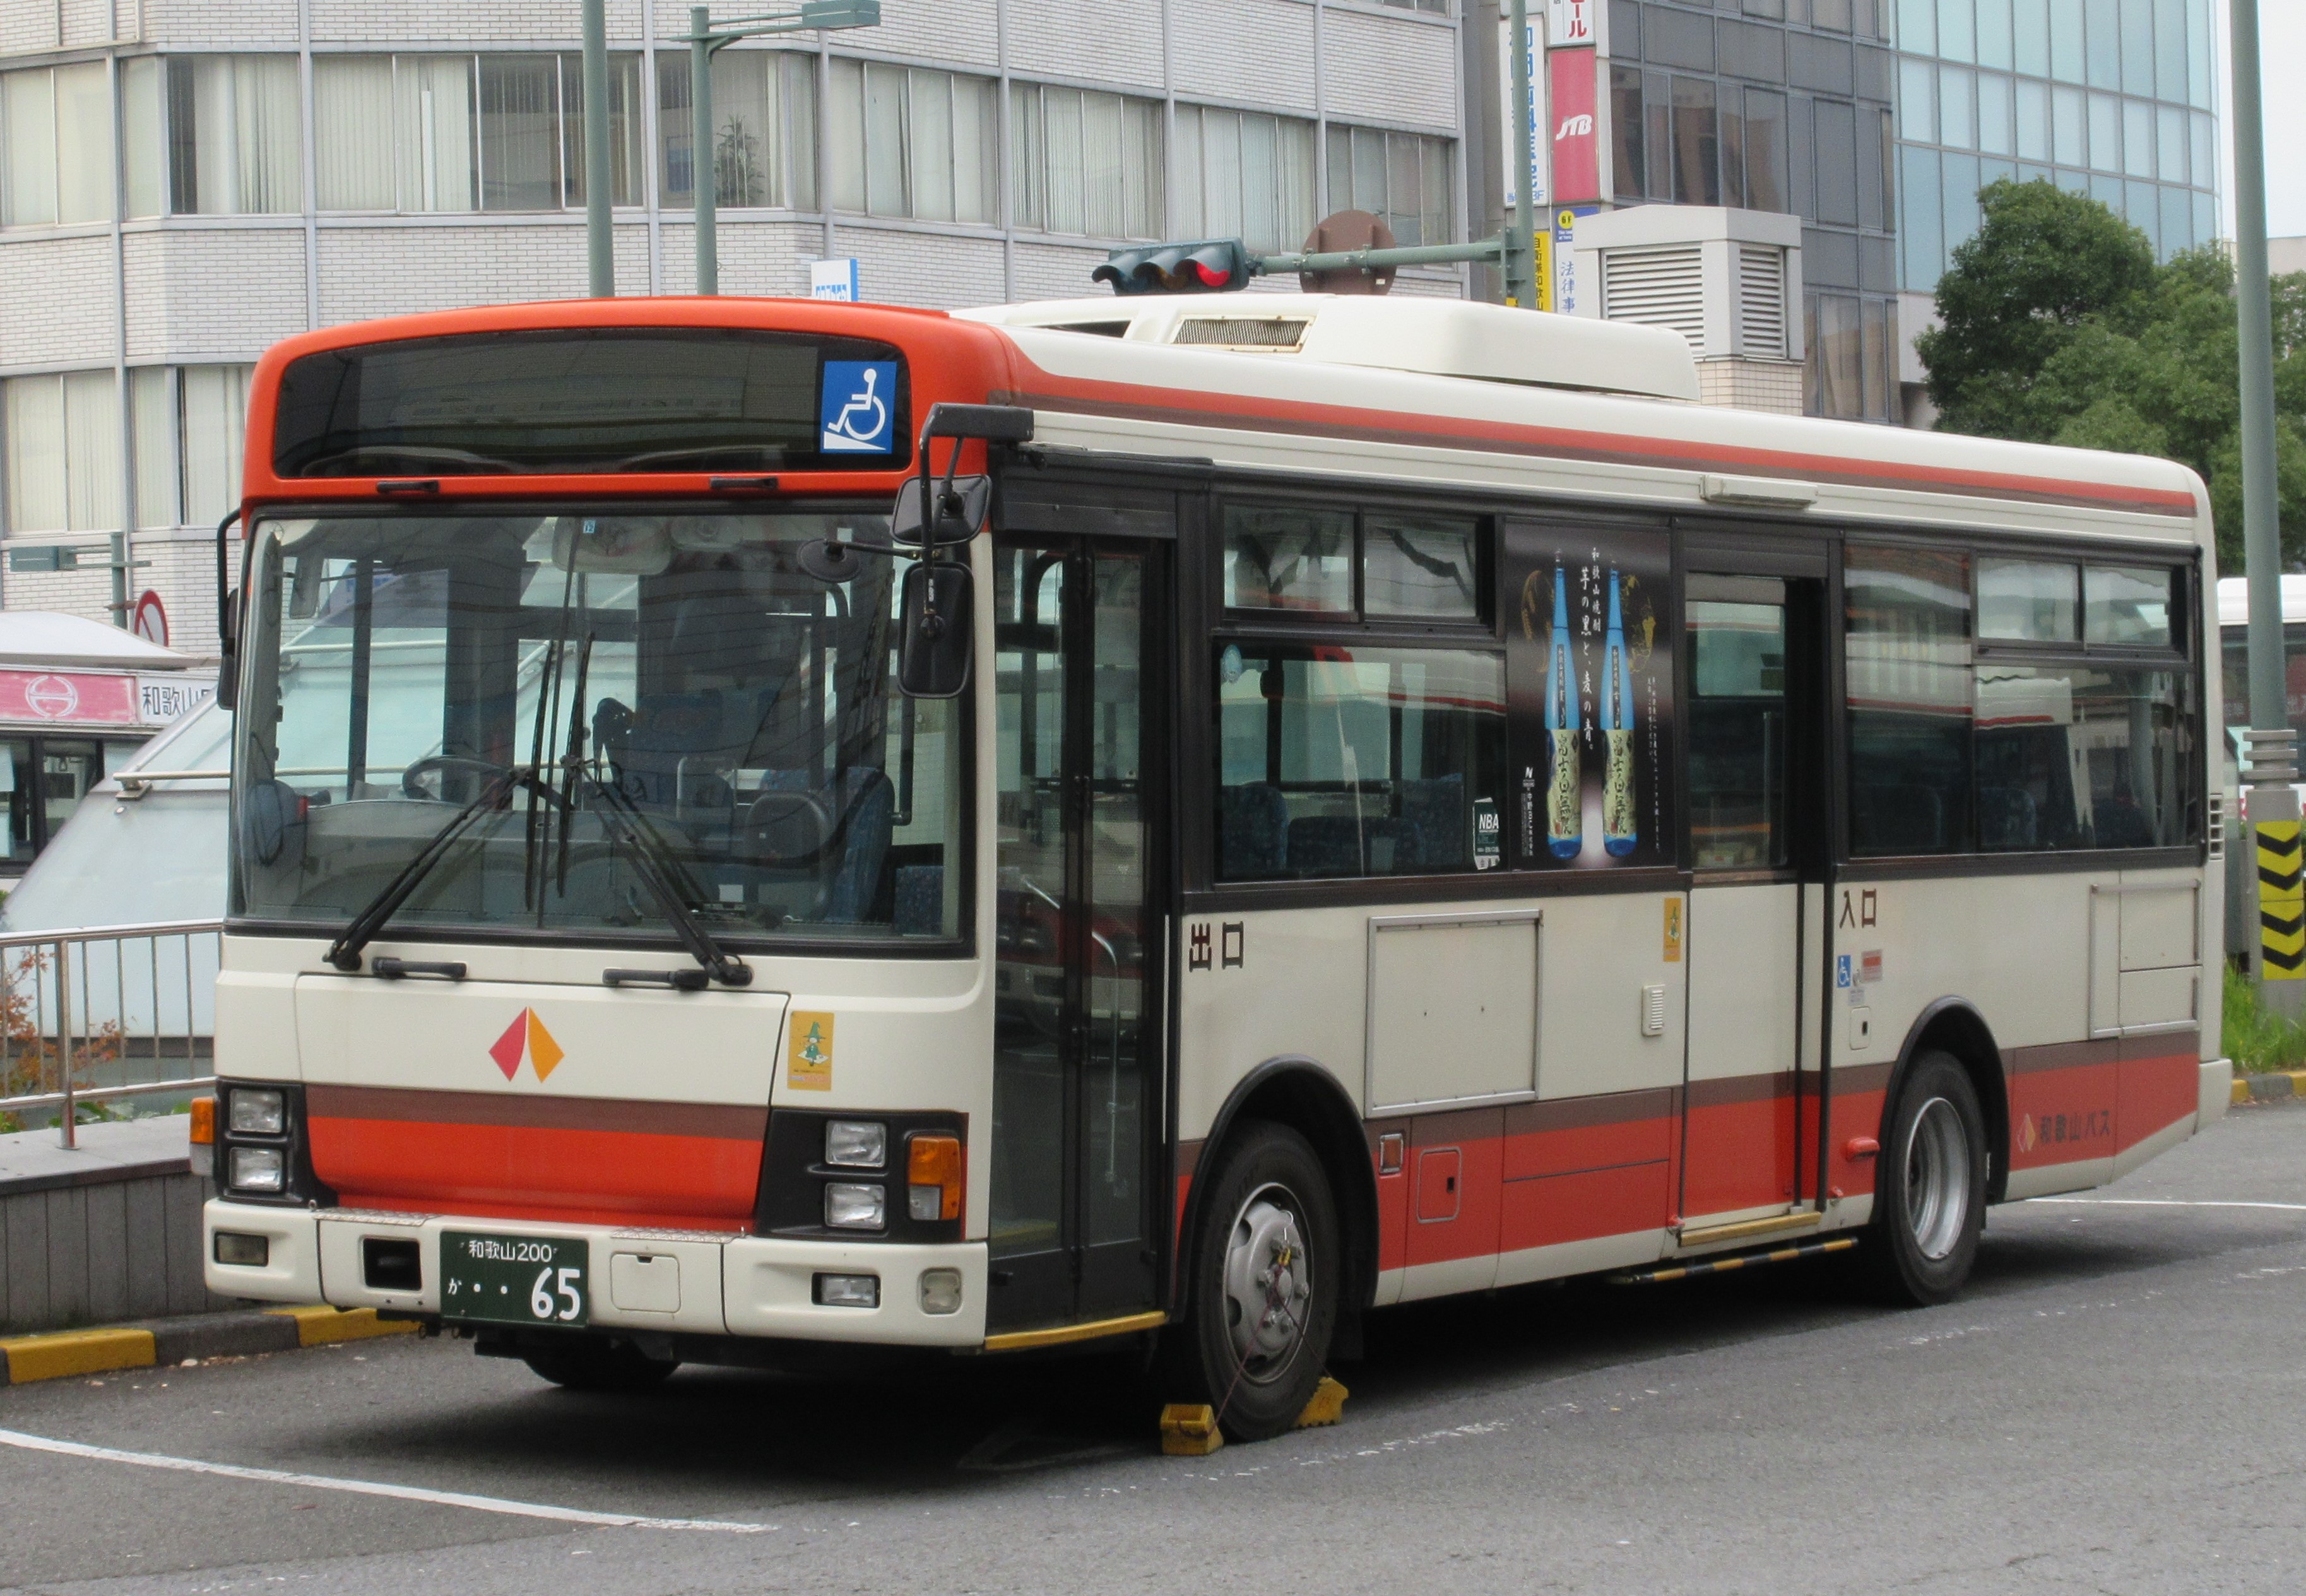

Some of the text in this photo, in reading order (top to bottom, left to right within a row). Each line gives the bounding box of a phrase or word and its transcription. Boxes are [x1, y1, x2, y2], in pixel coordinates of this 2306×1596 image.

[1568, 0, 1587, 37] ール
[1556, 114, 1592, 141] JTB
[1561, 261, 1576, 313] 法律事
[142, 686, 211, 716] 和歌山
[1479, 814, 1499, 829] NBA
[1839, 889, 1876, 929] 入口
[1189, 921, 1244, 972] 出口
